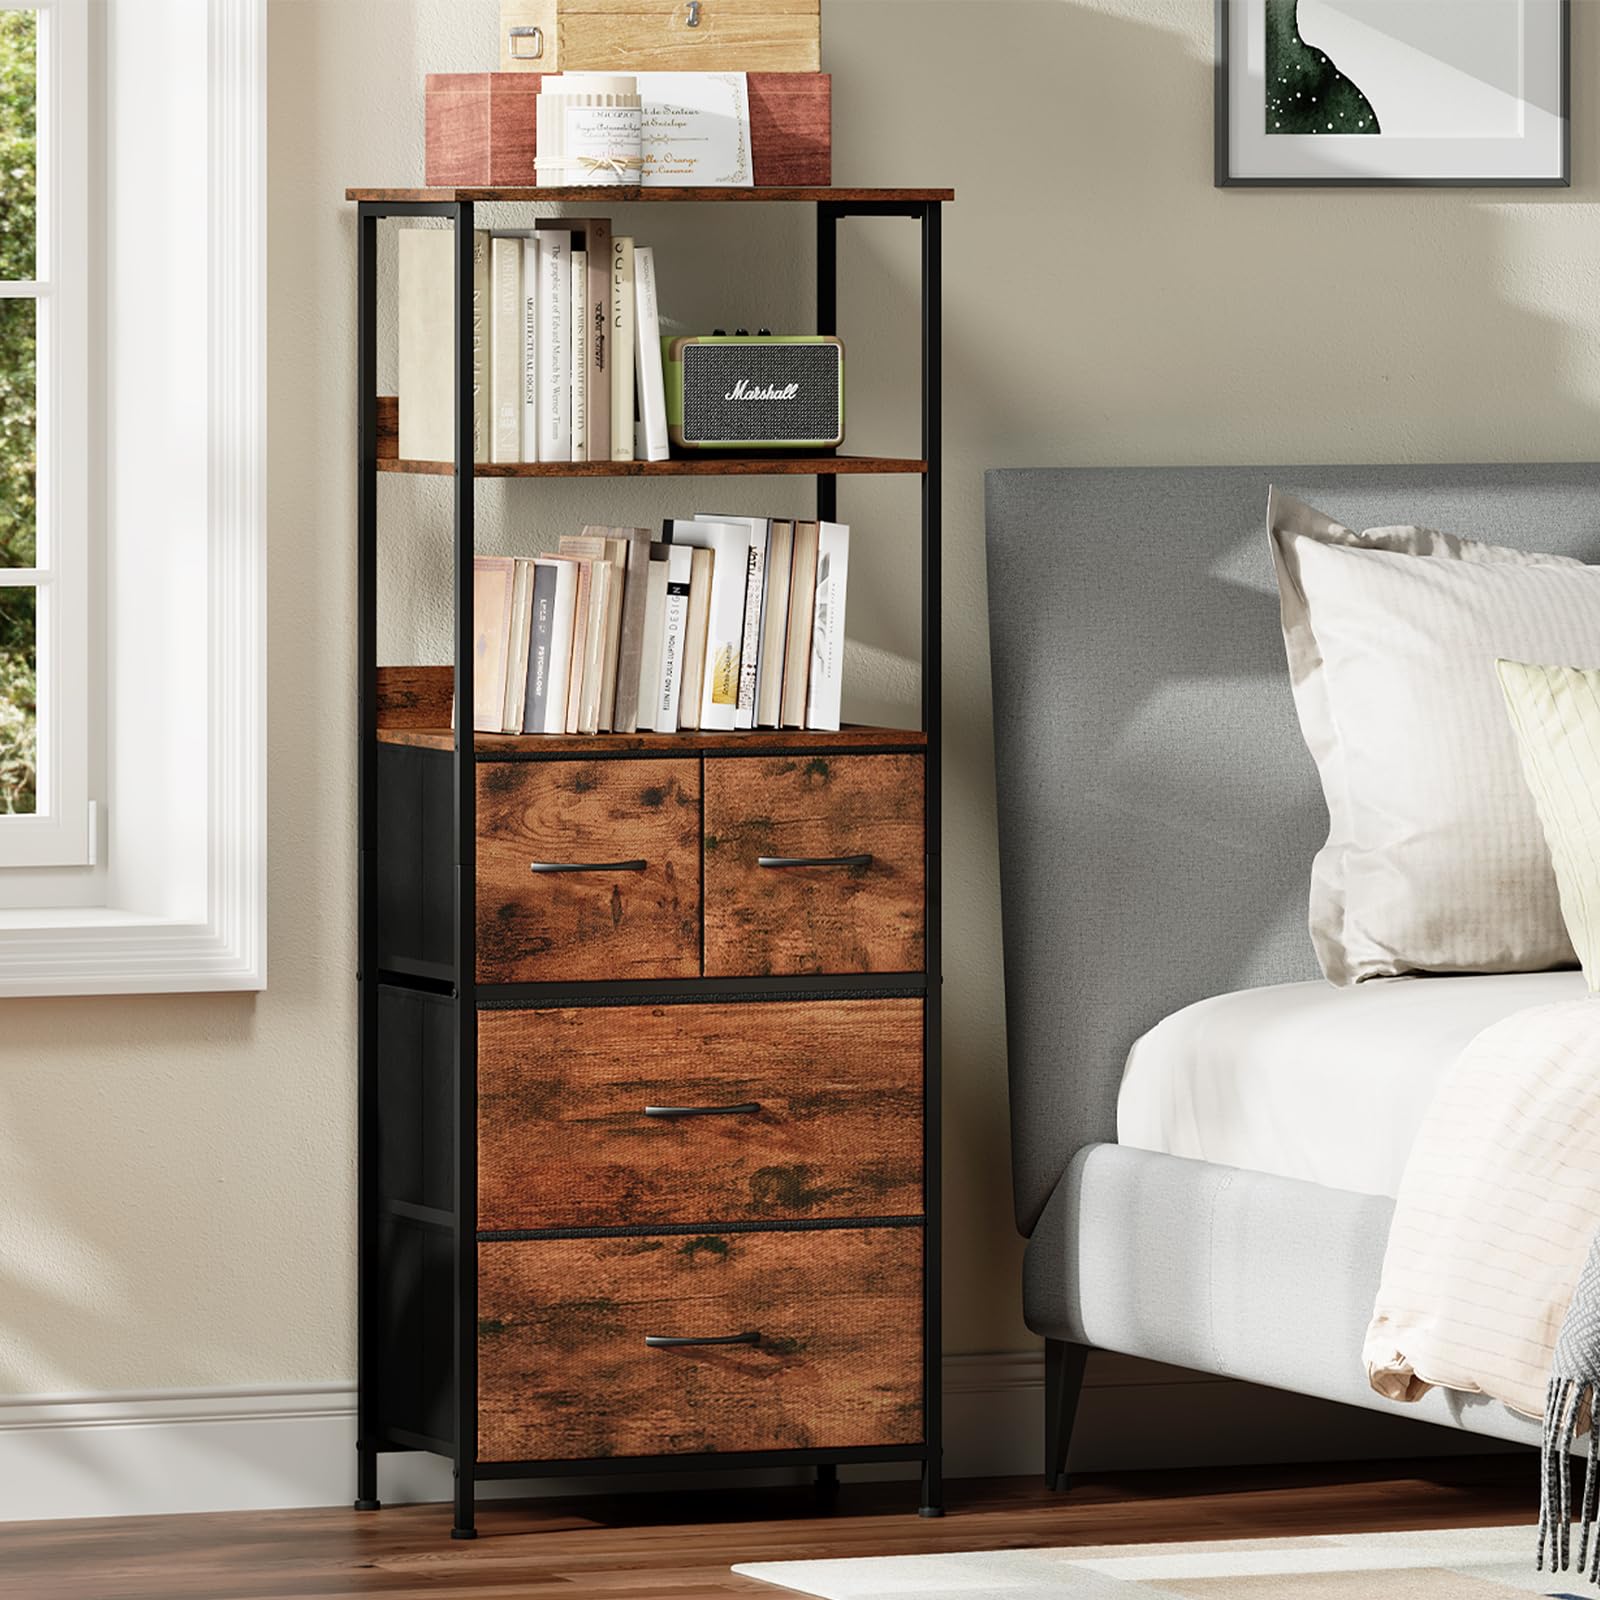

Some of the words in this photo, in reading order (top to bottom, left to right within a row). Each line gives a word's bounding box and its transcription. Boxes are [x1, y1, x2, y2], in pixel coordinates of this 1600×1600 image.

[552, 245, 561, 260] The
[551, 262, 561, 290] graphic
[552, 293, 560, 304] art
[552, 305, 560, 315] of
[552, 315, 561, 344] Edvard
[552, 345, 561, 372] Munch
[551, 374, 561, 384] by
[725, 379, 799, 400] Marshall
[552, 386, 561, 415] Werner
[669, 586, 681, 631] DESIGN
[667, 635, 676, 660] LUPTON
[536, 646, 545, 697] PSYCHOLOGY
[666, 660, 674, 677] JULIA
[664, 678, 672, 693] AND
[663, 693, 671, 711] ELLEN
